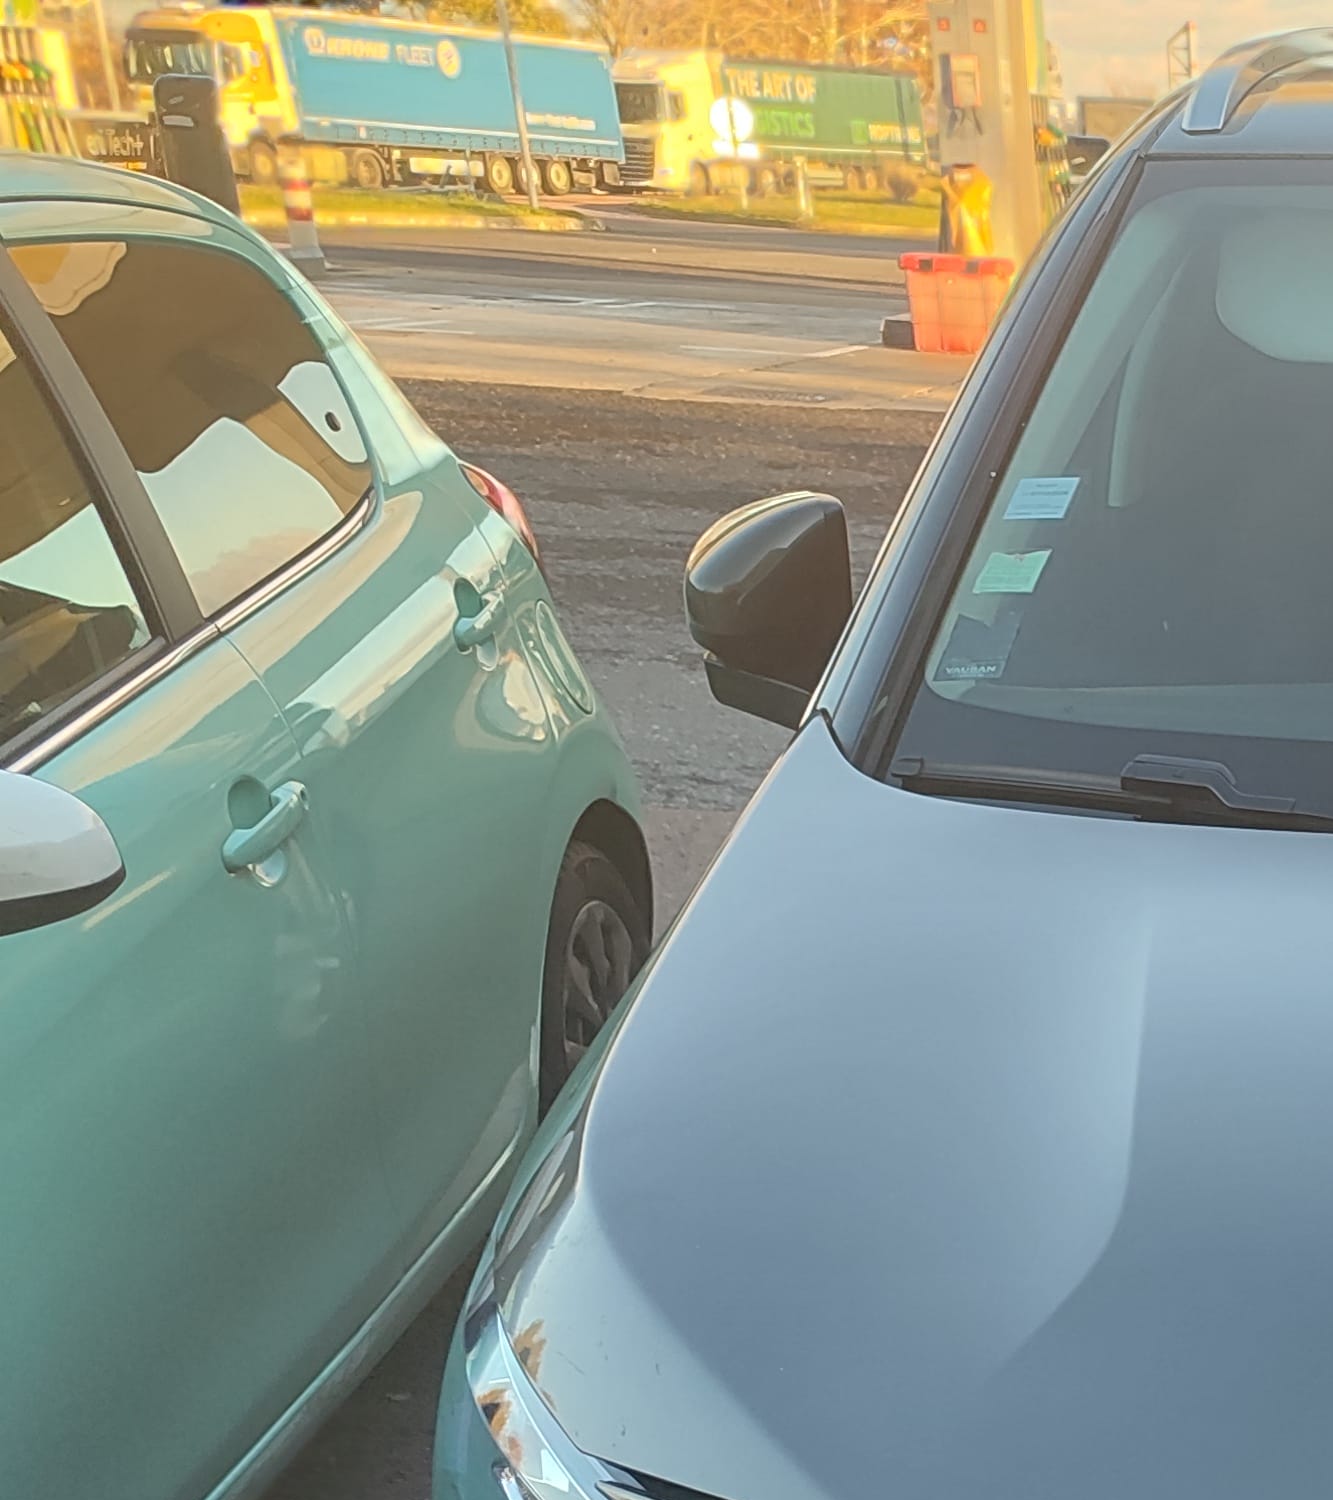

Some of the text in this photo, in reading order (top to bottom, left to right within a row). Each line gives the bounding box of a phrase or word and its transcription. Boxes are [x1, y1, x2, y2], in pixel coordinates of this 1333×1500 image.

[726, 68, 817, 104] THE ART OF
